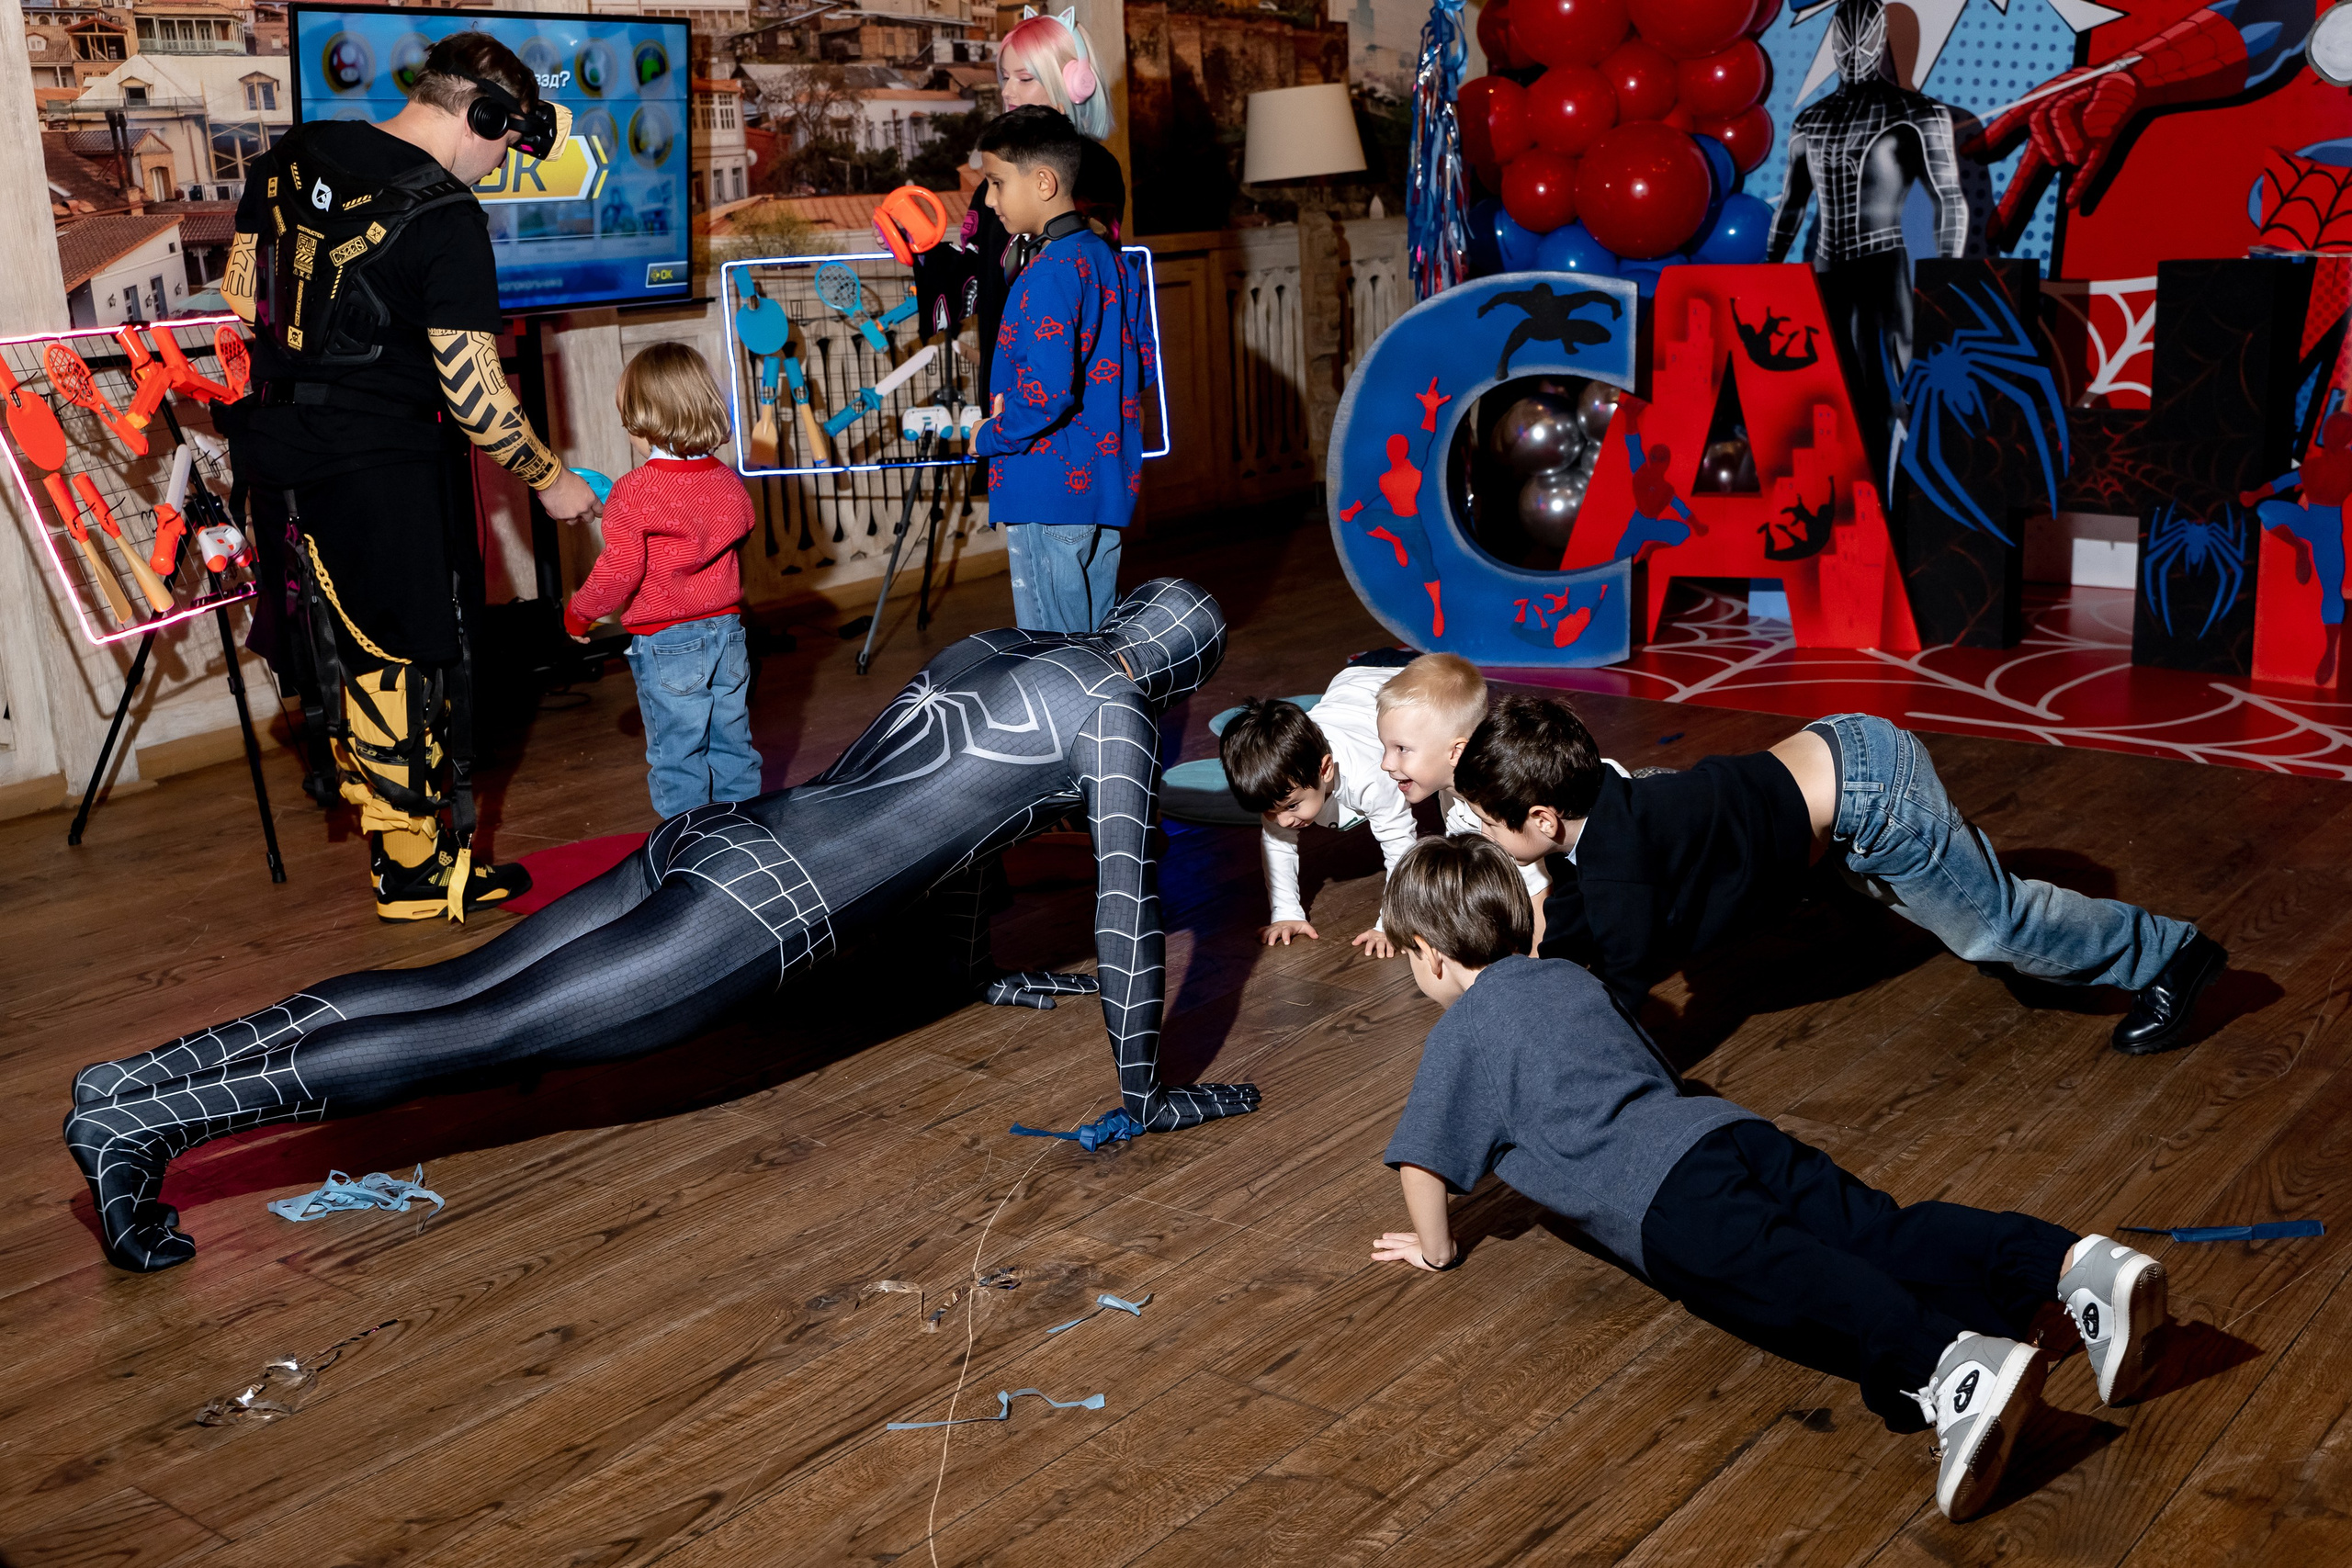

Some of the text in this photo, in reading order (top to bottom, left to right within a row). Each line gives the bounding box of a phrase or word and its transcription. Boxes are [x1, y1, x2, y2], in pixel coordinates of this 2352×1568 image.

[534, 70, 571, 89] езд?
[660, 269, 673, 280] OK
[1328, 259, 2352, 687] САН
